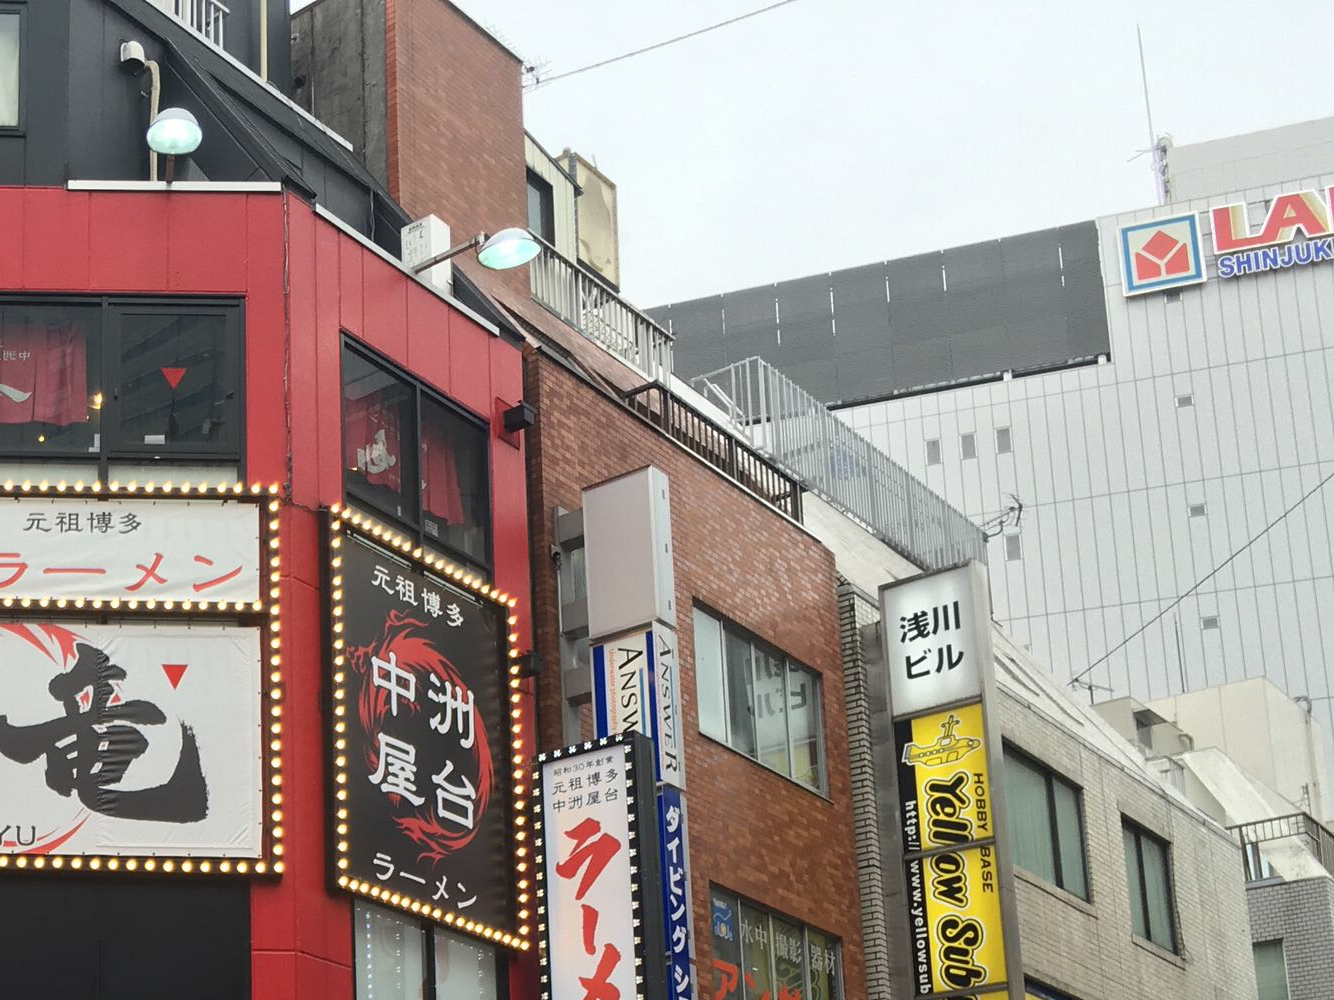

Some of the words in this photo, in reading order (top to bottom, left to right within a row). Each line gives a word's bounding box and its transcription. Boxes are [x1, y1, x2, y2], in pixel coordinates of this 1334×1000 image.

[1209, 188, 1334, 254] LA
[22, 512, 144, 535] 元祖博多
[371, 564, 464, 629] 元祖博多
[899, 600, 961, 644] 浅川
[904, 644, 964, 680] ビル
[658, 634, 678, 773] ANSWER
[552, 770, 619, 796] 元祖博多
[553, 755, 614, 776] 昭和30年創業
[552, 788, 619, 813] 中洲屋台
[974, 772, 988, 832] HOBBY
[926, 771, 974, 907] Yellow
[373, 851, 478, 910] ラーメン
[664, 804, 690, 954] ダイビング
[980, 847, 994, 893] BASE
